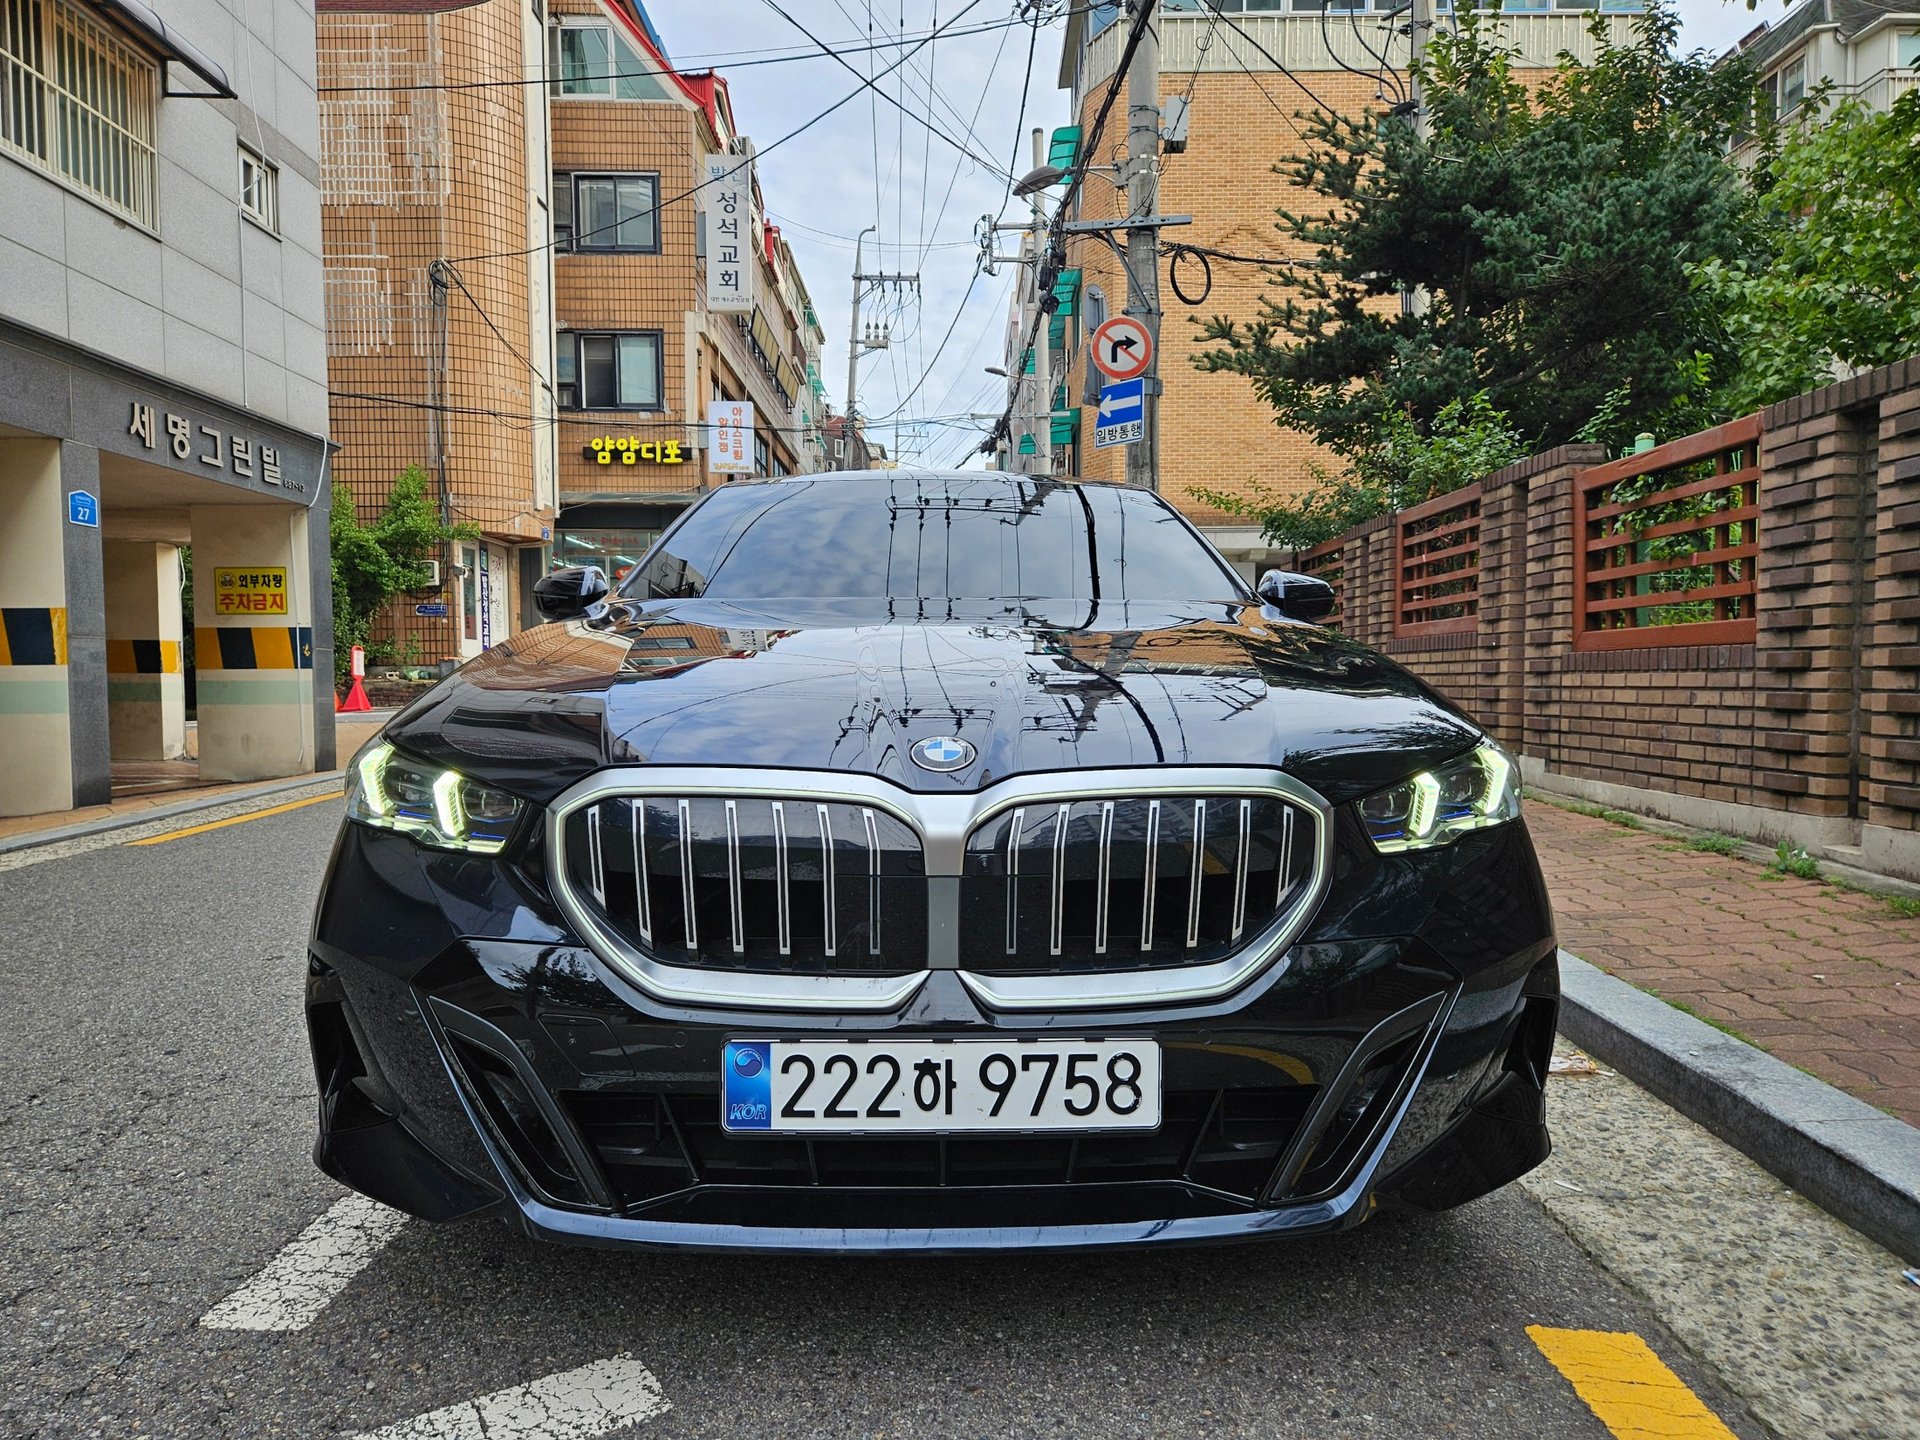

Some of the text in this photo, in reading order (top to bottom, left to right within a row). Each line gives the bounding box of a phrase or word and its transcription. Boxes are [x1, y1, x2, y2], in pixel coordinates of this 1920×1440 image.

[716, 192, 740, 292] 성석교회
[129, 402, 283, 486] 세명그린빌
[731, 406, 744, 461] 아이스크림
[1096, 422, 1142, 444] 일방통행
[590, 435, 685, 466] 얌얌디포
[77, 507, 90, 521] 27
[238, 573, 283, 588] 외부차량
[219, 592, 285, 611] 주차금지
[780, 1053, 1143, 1118] 222하 9758
[730, 1103, 767, 1120] KOR
